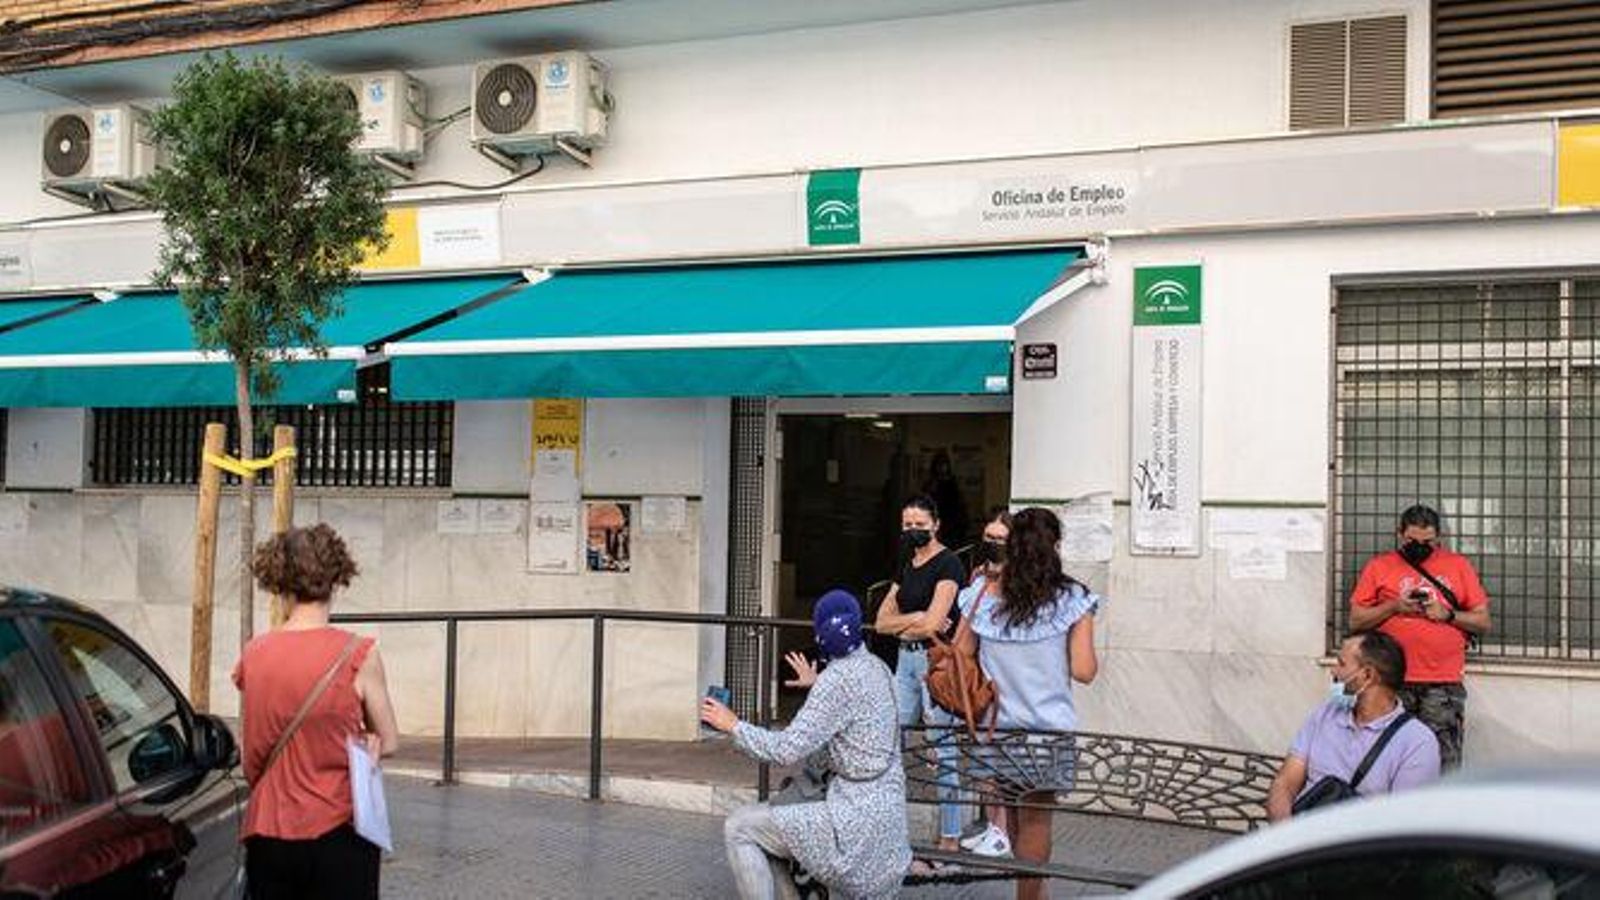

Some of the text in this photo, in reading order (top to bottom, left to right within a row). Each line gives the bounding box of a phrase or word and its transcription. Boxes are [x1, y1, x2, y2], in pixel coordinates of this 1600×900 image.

[991, 184, 1125, 206] Oficina de Empleo
[982, 203, 1126, 221] Servicio Andaluz de Empleo
